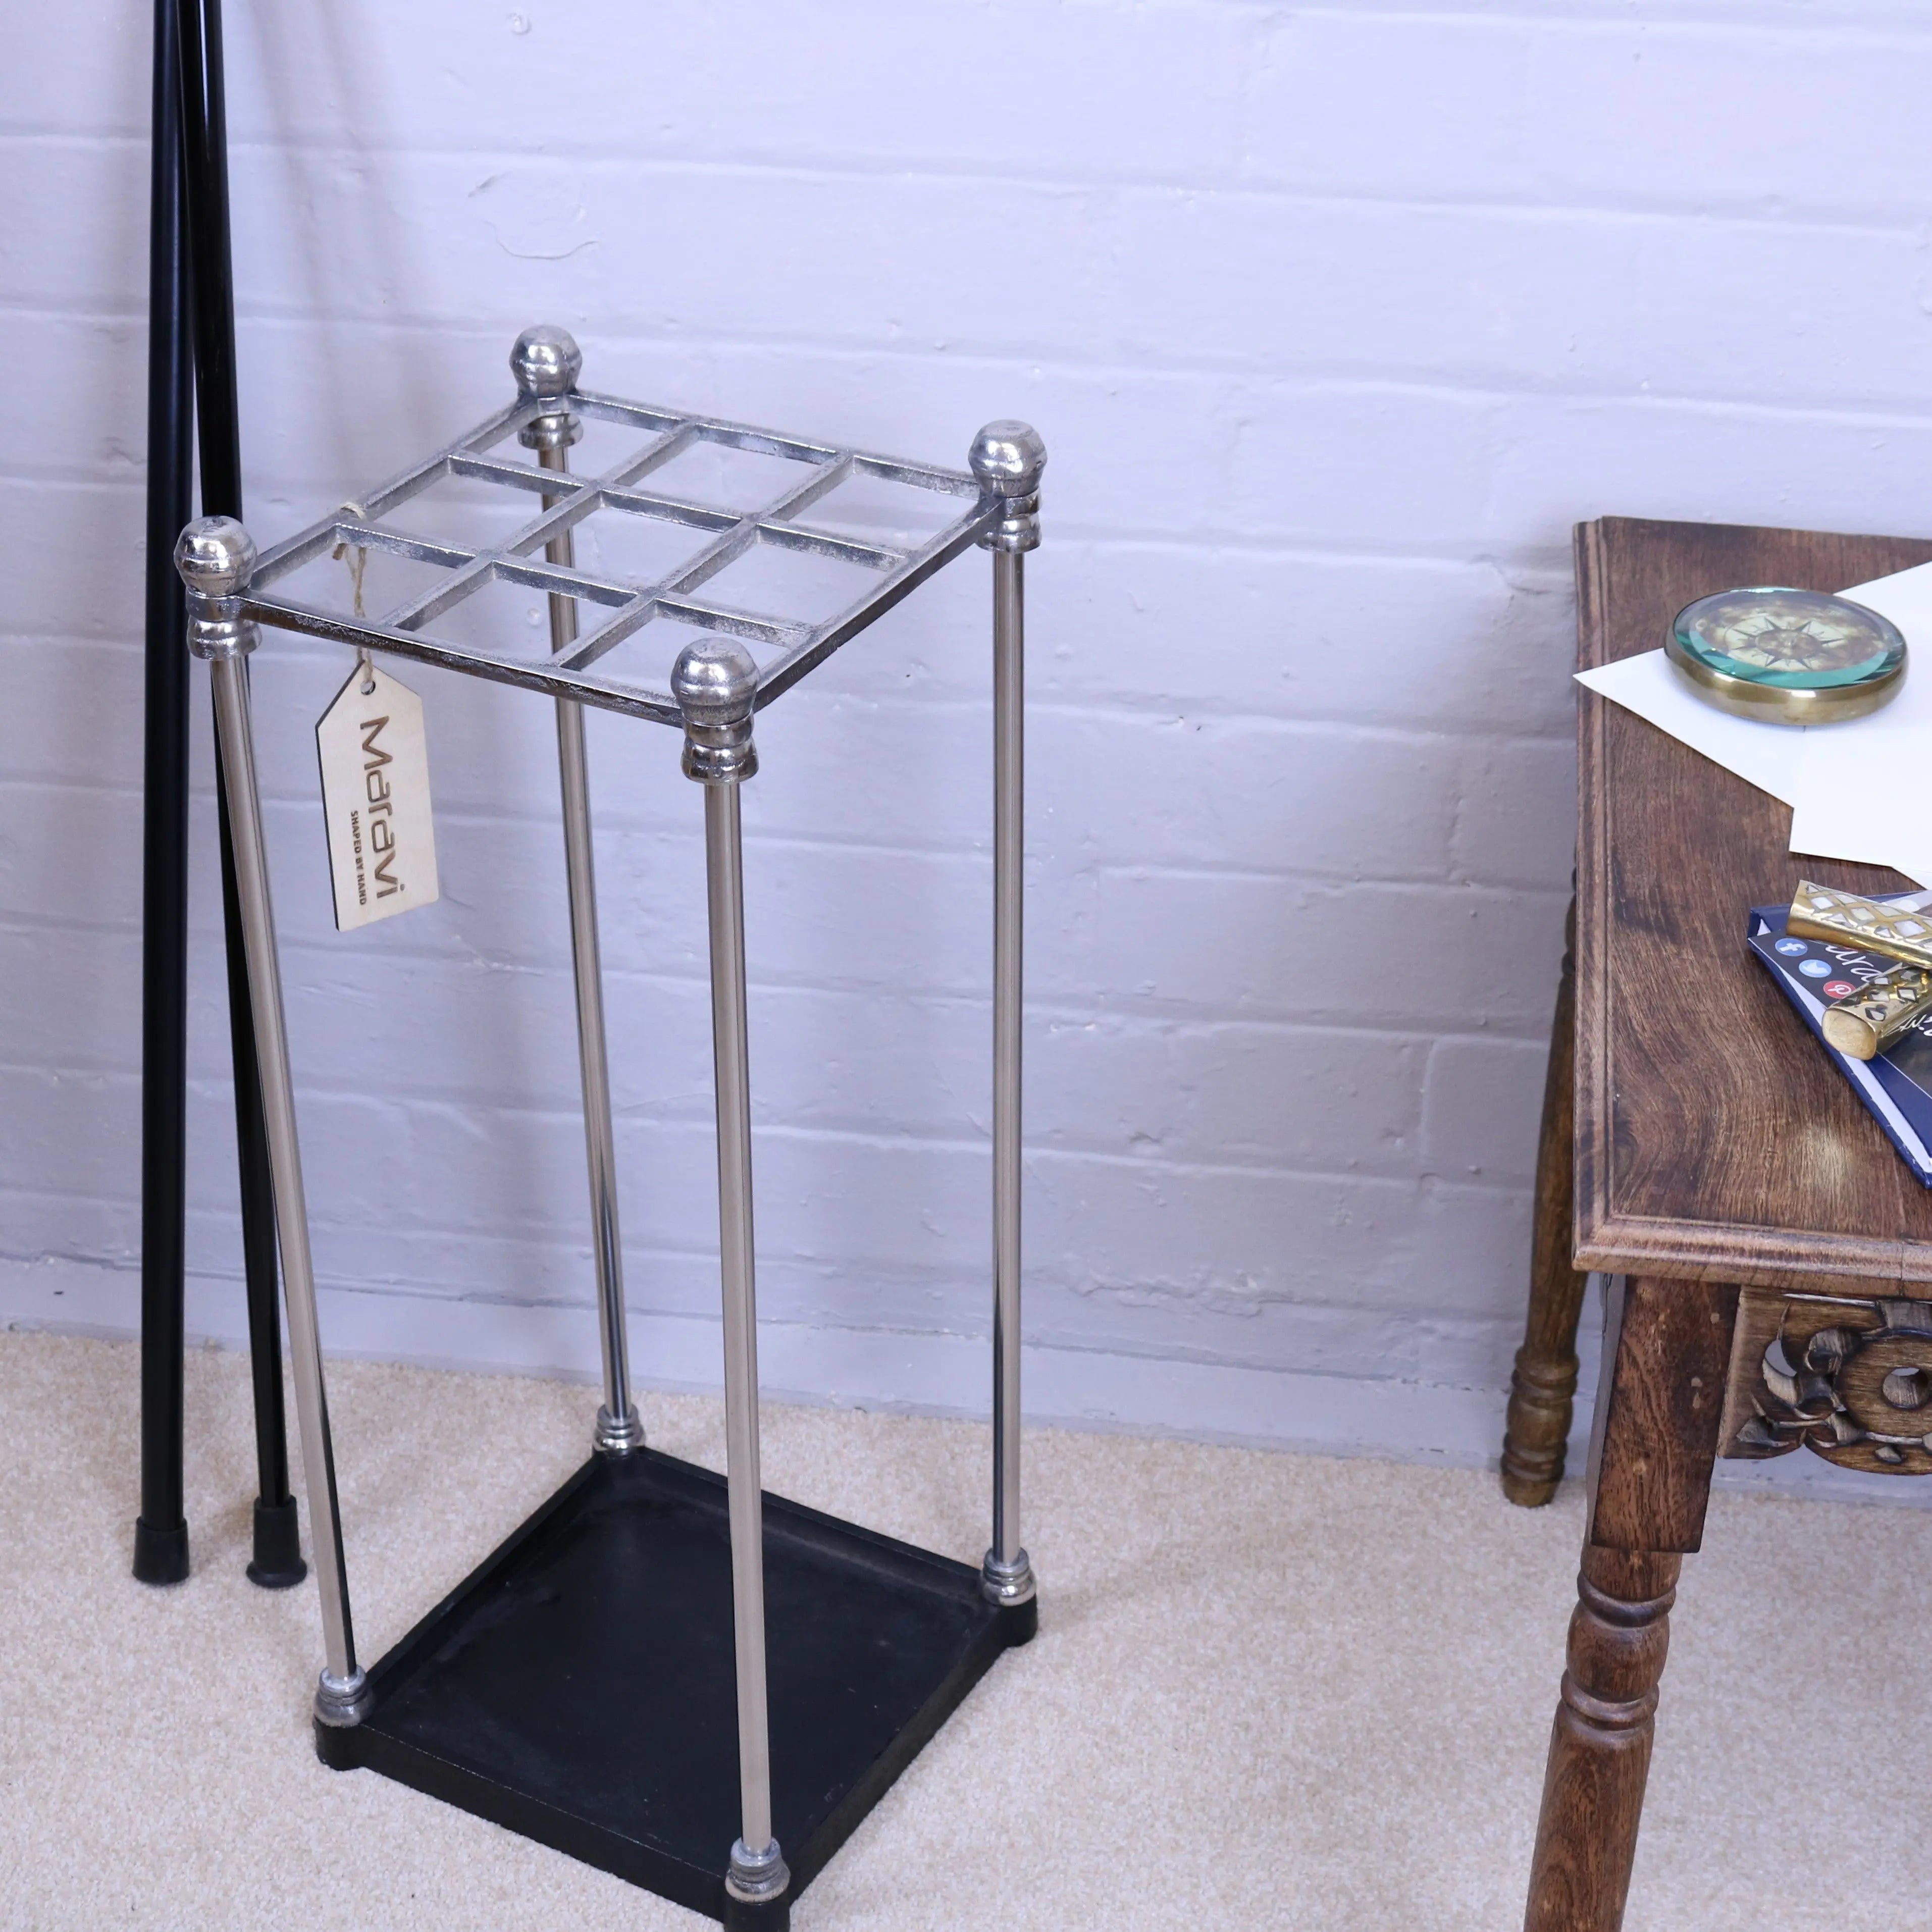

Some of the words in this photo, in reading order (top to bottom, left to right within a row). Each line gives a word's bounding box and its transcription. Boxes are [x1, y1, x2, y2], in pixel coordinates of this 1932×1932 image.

[359, 716, 405, 899] Maravi
[351, 810, 362, 854] SHAPED
[355, 857, 364, 870] BY
[357, 873, 367, 905] HAND
